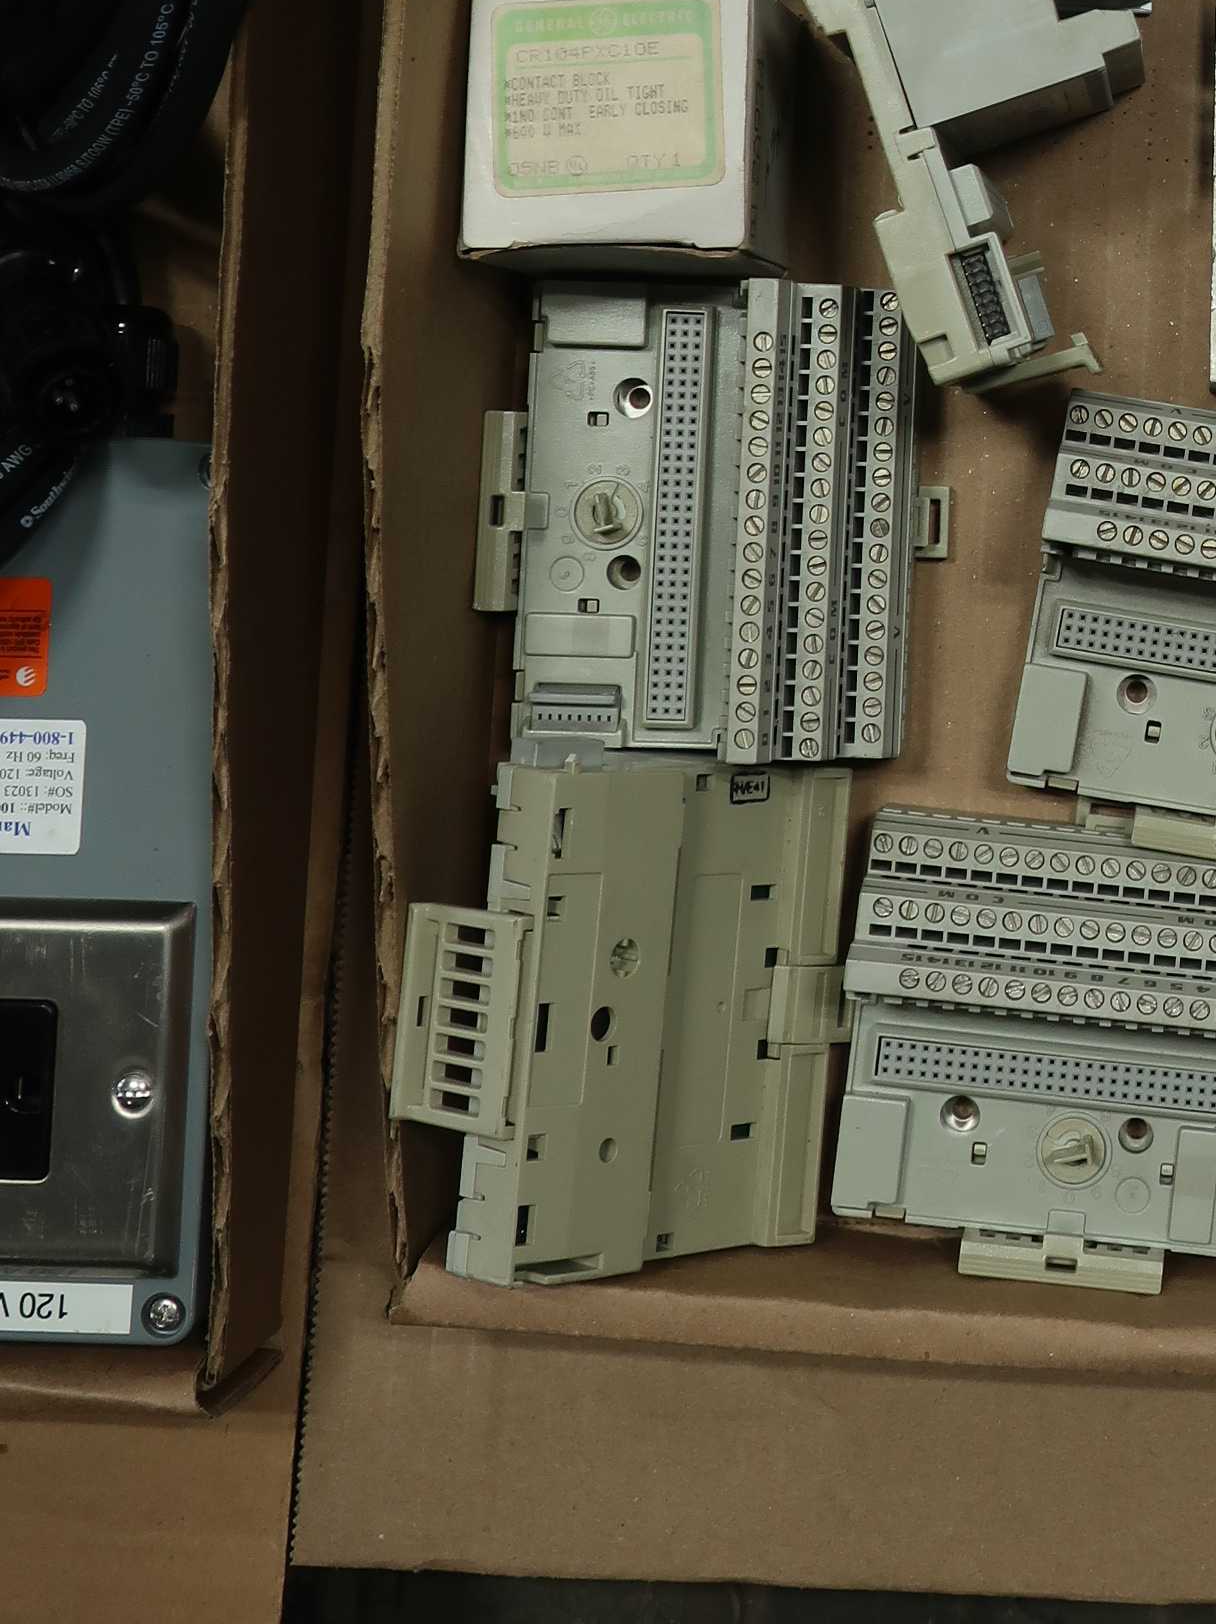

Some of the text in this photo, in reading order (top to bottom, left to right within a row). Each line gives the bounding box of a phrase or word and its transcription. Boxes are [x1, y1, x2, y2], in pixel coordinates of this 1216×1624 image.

[626, 84, 665, 100] TIGHT
[634, 99, 689, 116] CLOSING
[6, 749, 75, 763] Freq: 60 Hz
[4, 785, 73, 797] SO#: 13023
[20, 1292, 68, 1319] 120
